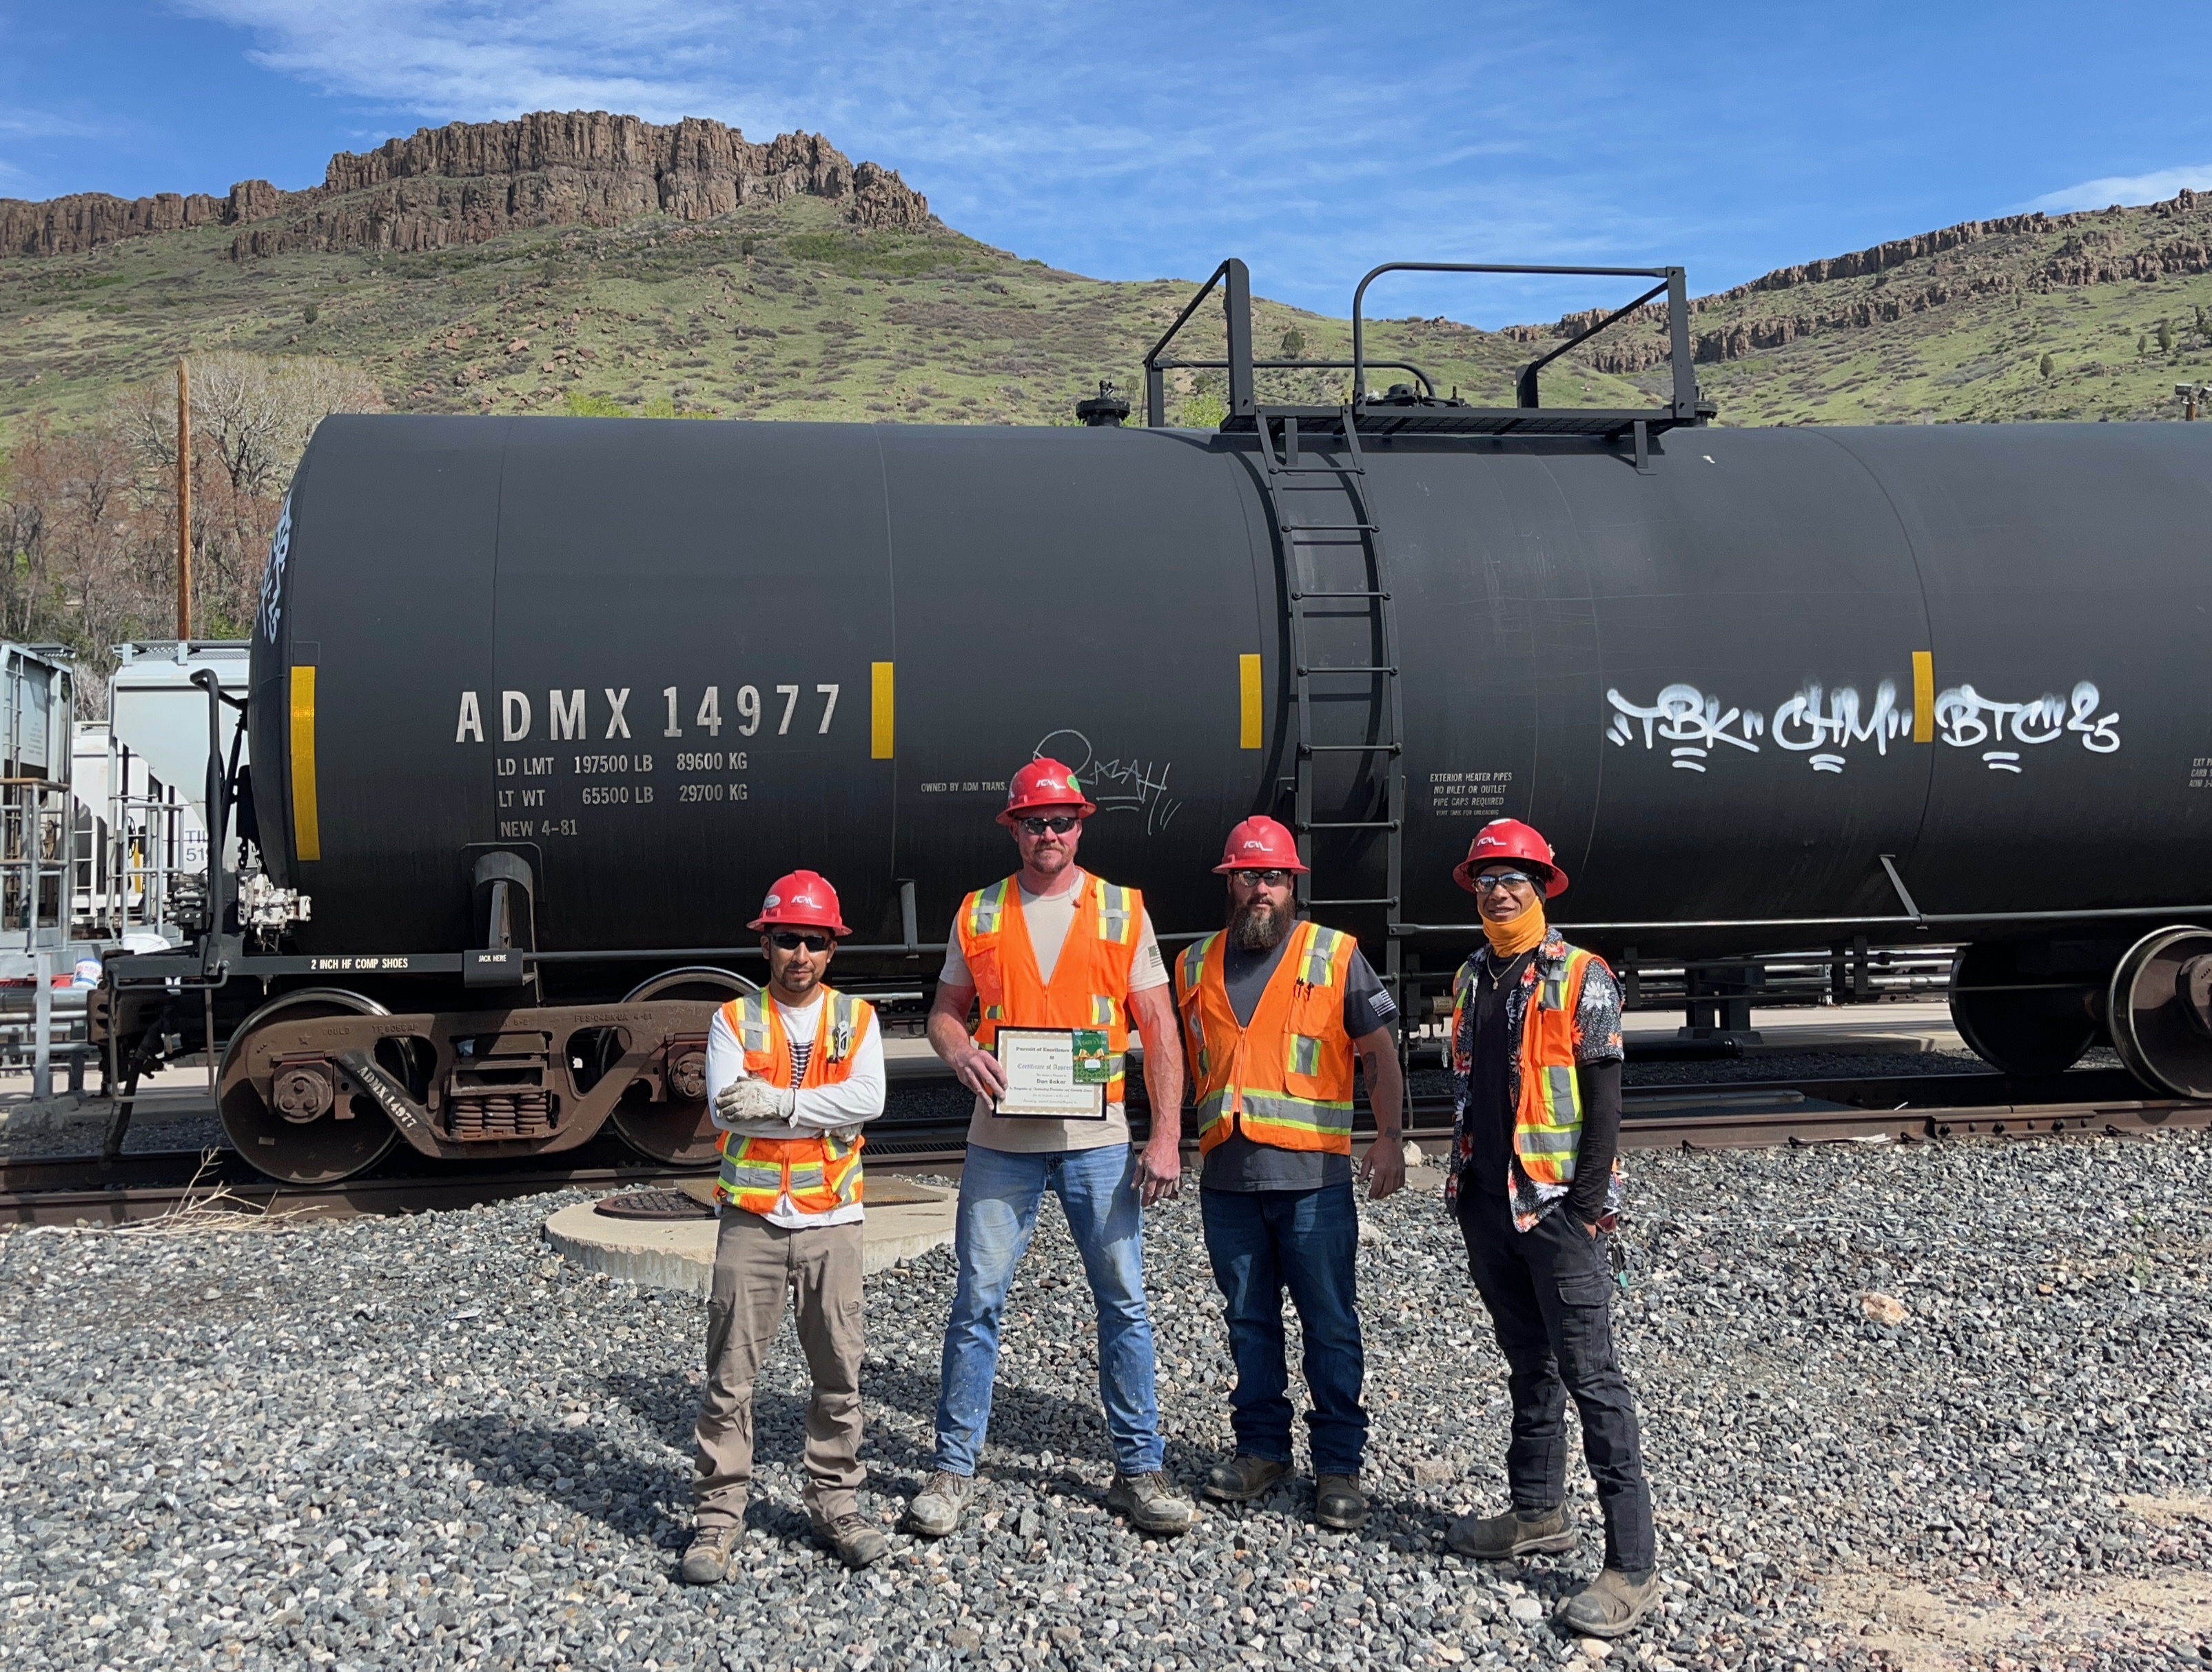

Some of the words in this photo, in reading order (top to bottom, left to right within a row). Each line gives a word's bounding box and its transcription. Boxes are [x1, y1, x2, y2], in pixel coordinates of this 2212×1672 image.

[455, 688, 632, 743] ADMX
[663, 684, 840, 738] 14977
[497, 758, 516, 777] LD
[523, 757, 554, 775] LMT
[574, 755, 628, 774] 197500
[634, 754, 653, 773] LB
[676, 752, 723, 771] 89600
[728, 752, 748, 770] KG
[2193, 758, 2205, 766] EXT
[1429, 773, 1463, 782] EXTERIOR
[1465, 773, 1491, 782] HEATER
[1493, 772, 1513, 781] PIPES
[921, 782, 947, 793] OWNED
[950, 782, 959, 792] BY
[962, 782, 979, 791] ADM
[981, 781, 1007, 791] TRANS.
[1433, 786, 1444, 794] NO
[1446, 785, 1466, 794] INLET
[1468, 785, 1477, 793] OR
[1480, 784, 1506, 793] OUTLET
[498, 790, 515, 808] LT
[522, 789, 546, 807] WT
[582, 786, 629, 805] 65500
[635, 786, 654, 804] LB
[679, 784, 723, 802] 29700
[728, 784, 748, 801] KG
[1433, 797, 1448, 806] PIPE
[1451, 797, 1469, 806] CAPS
[1471, 797, 1504, 807] REQUIRED
[500, 820, 533, 837] NEW
[541, 819, 578, 836] 4-81
[186, 847, 207, 862] 51
[311, 960, 317, 970] 2
[319, 959, 338, 970] INCH
[341, 959, 352, 969] HF
[355, 959, 378, 969] COMP
[382, 958, 409, 968] SHOES
[385, 1094, 418, 1128] 14977
